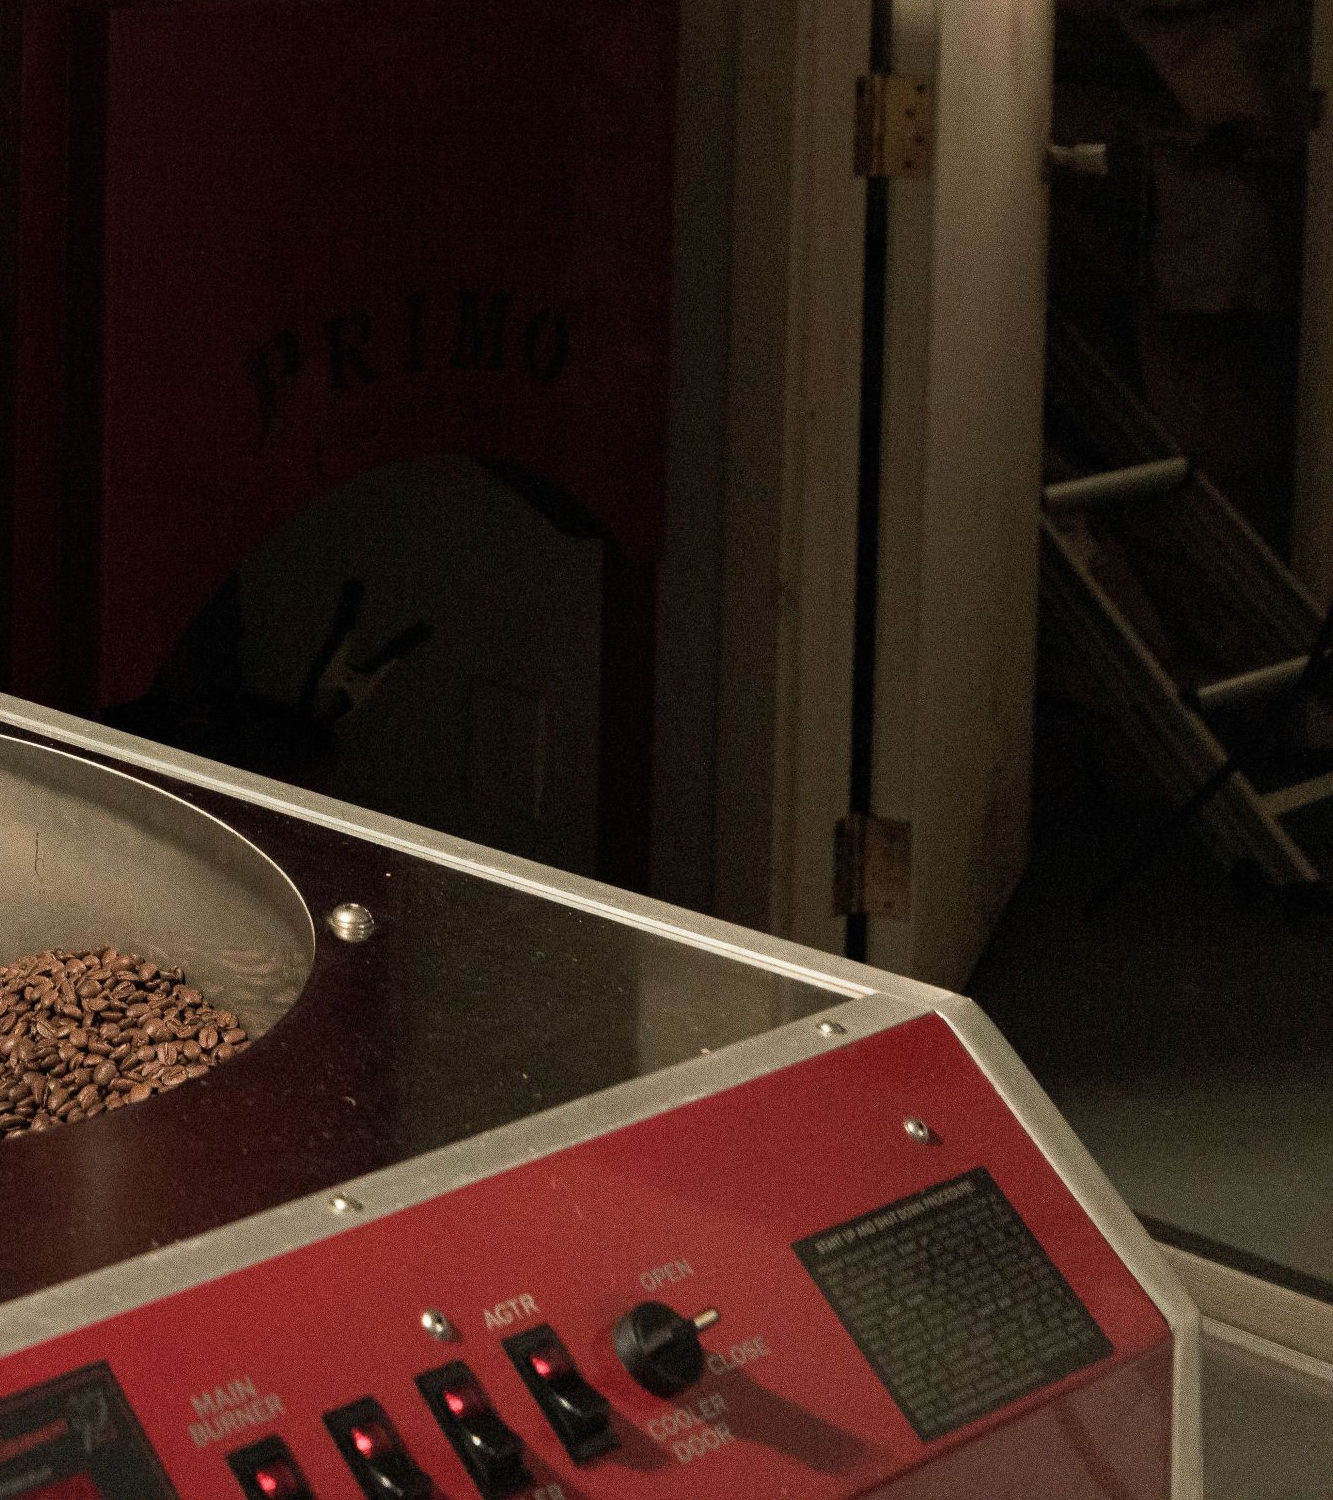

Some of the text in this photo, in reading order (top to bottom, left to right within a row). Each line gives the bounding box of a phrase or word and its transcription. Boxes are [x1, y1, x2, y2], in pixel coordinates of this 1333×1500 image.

[246, 290, 569, 443] PRIMO
[638, 1259, 694, 1292] OPEN
[483, 1293, 540, 1330] AGTR
[705, 1336, 772, 1375] CLOSE
[190, 1375, 258, 1417] MAIN
[647, 1393, 727, 1442] COOLER
[188, 1393, 283, 1448] BURNER
[672, 1421, 733, 1465] DOOR
